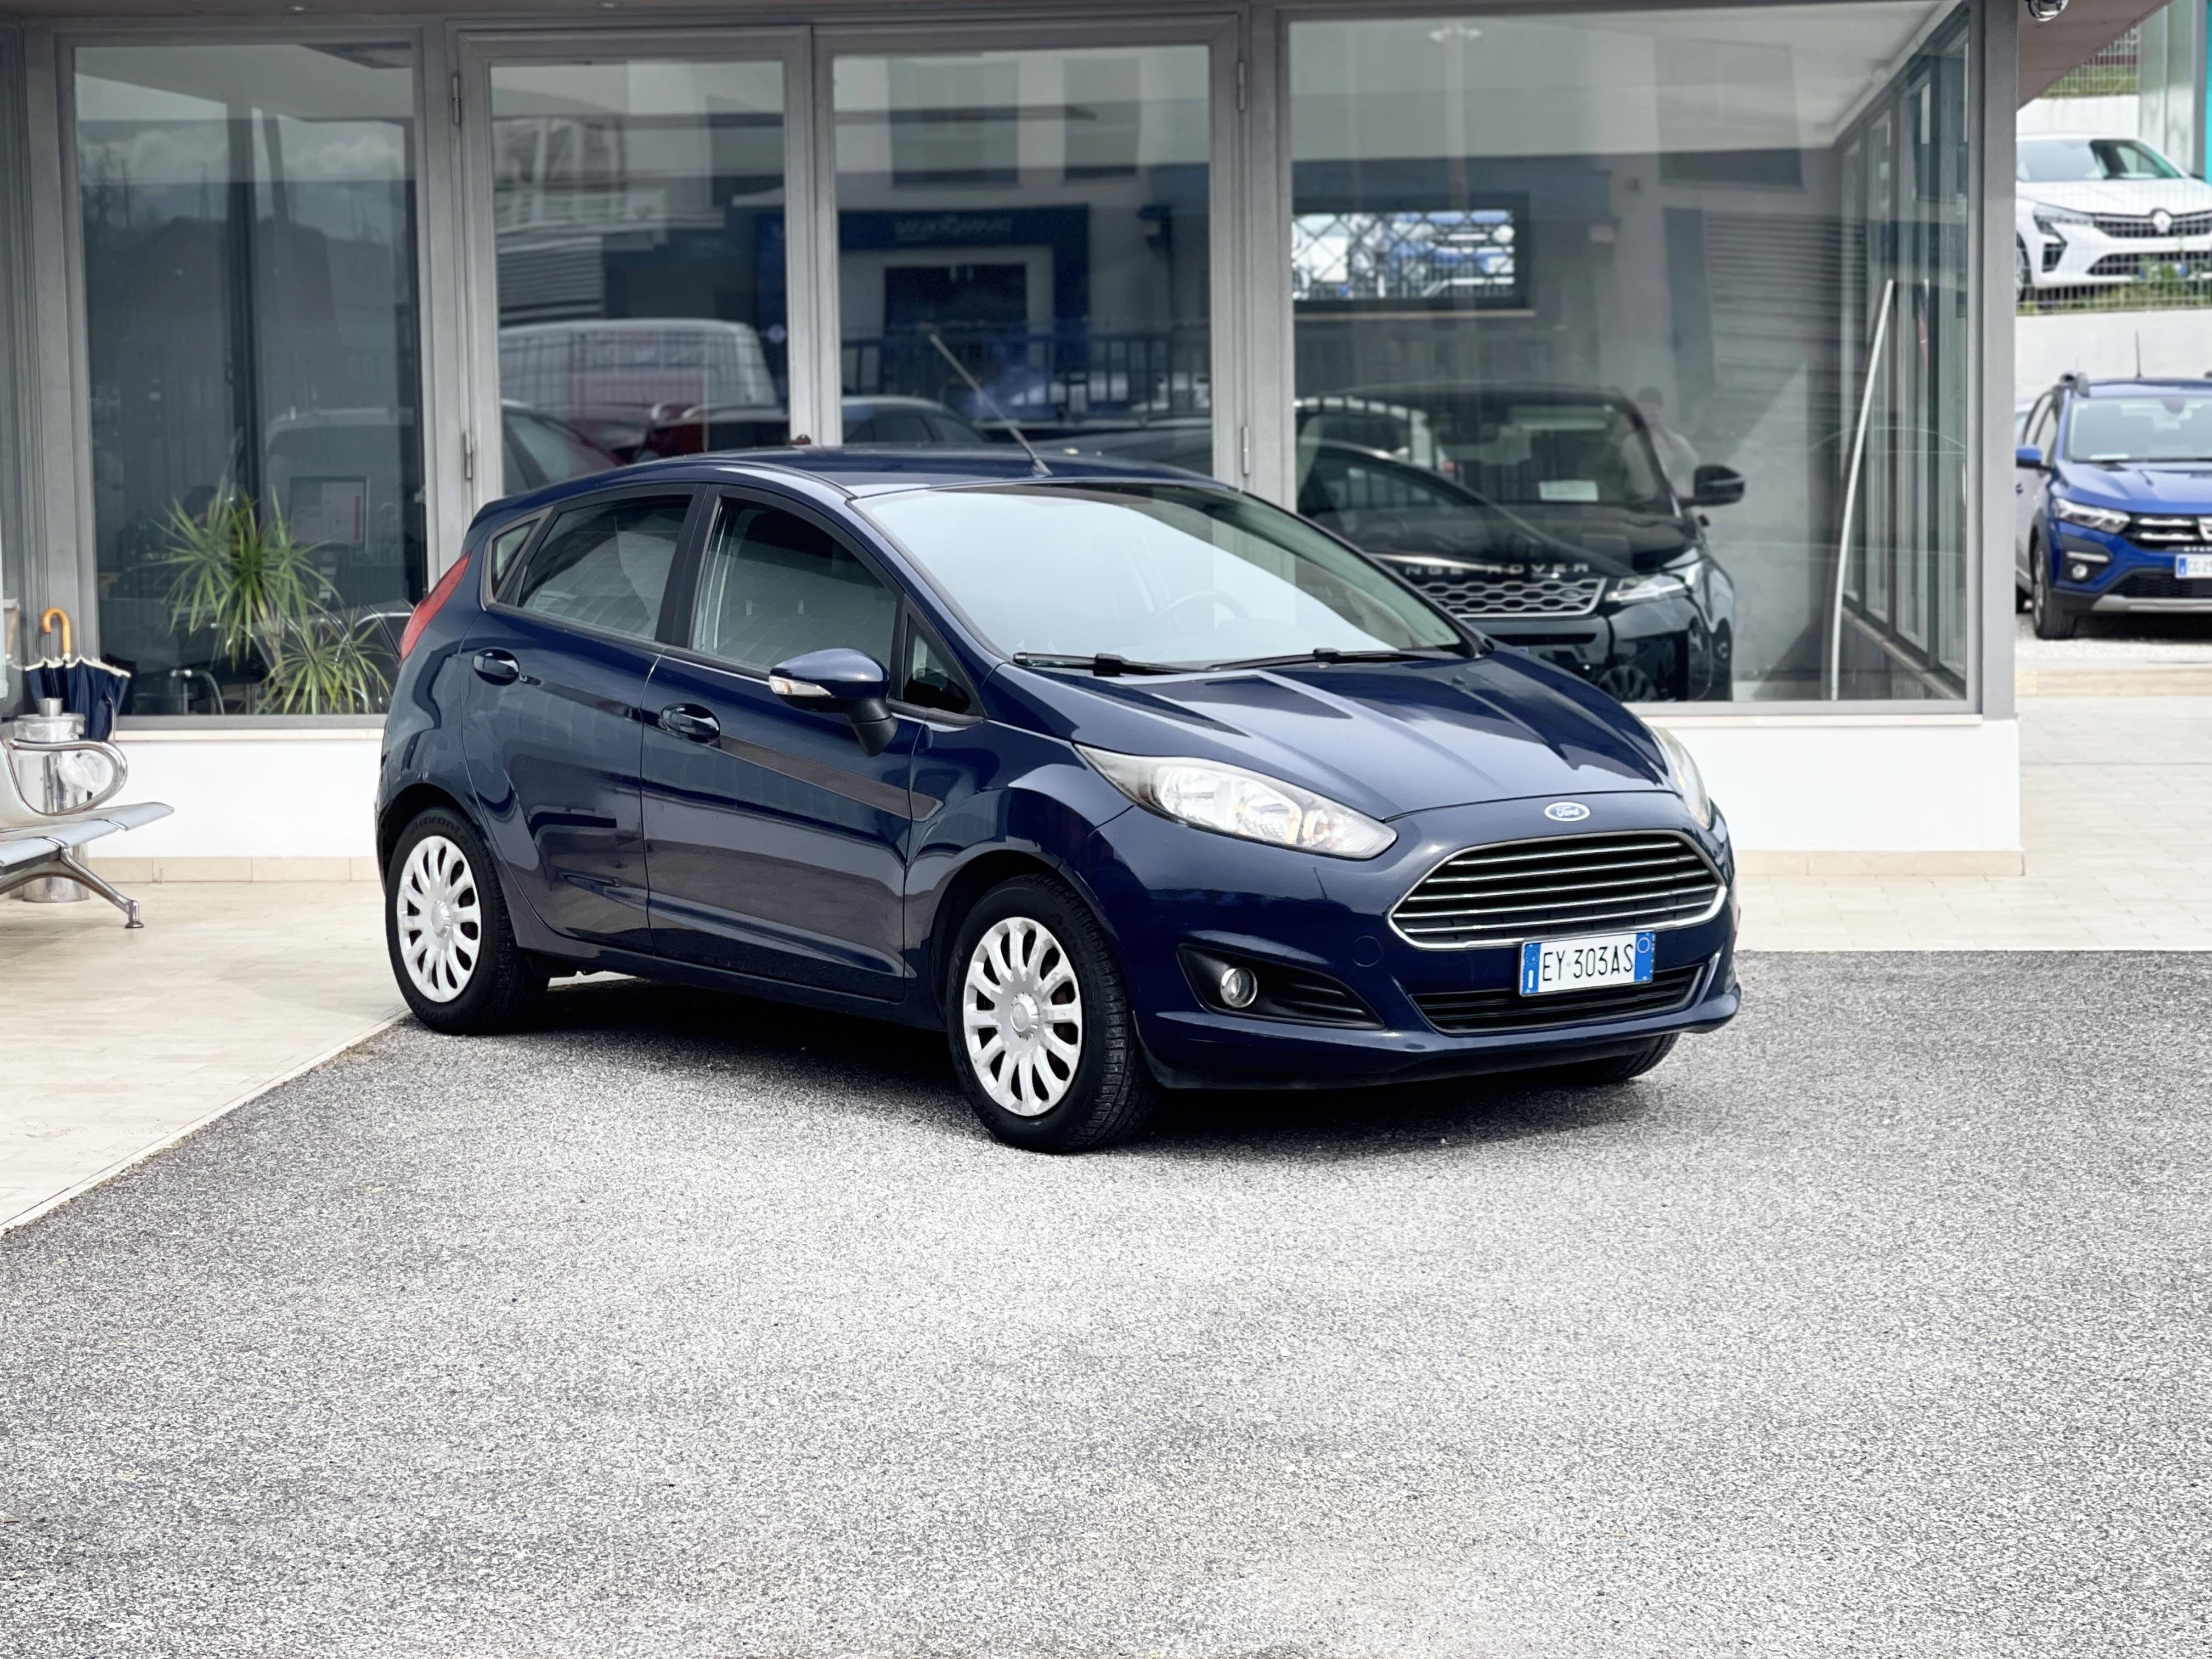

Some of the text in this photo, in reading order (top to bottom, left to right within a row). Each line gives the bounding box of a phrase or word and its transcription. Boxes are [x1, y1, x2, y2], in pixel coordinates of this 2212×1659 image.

[1487, 563, 1589, 574] ROVER
[1556, 806, 1579, 817] Ford
[1543, 944, 1634, 981] EY 303AS
